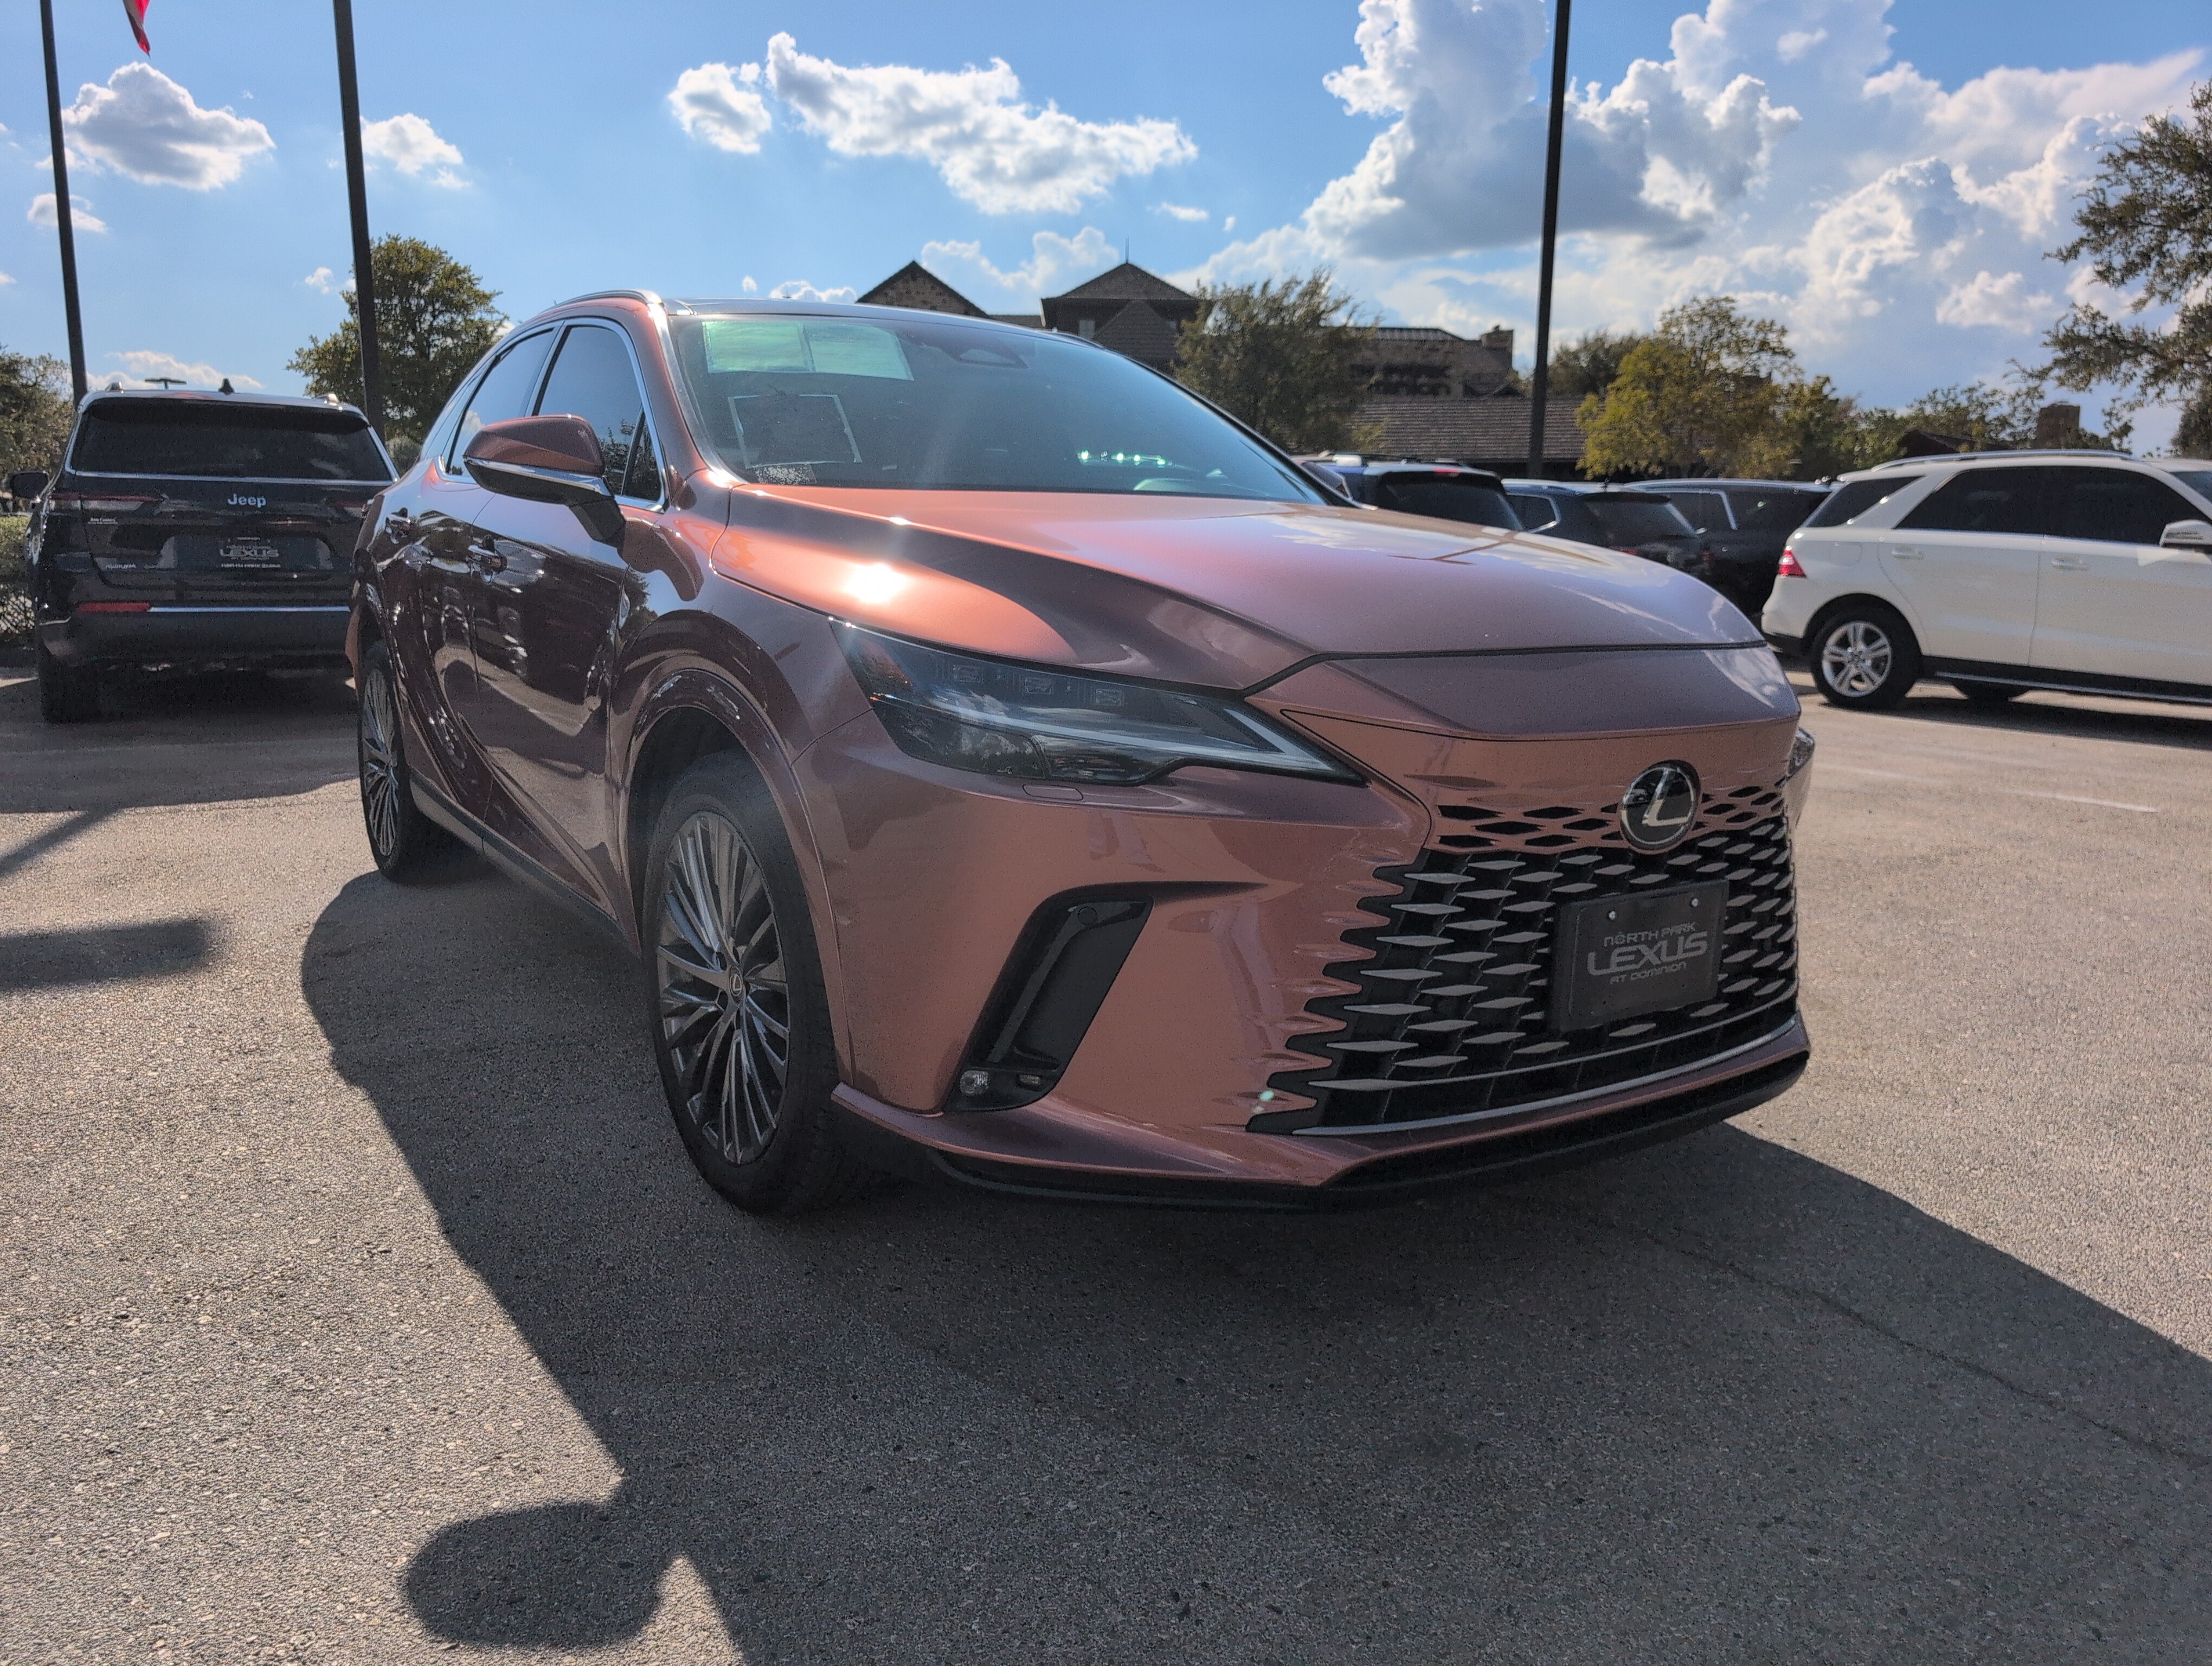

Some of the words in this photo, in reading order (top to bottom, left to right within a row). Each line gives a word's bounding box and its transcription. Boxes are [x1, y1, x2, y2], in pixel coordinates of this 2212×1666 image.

[227, 493, 266, 508] Jeep
[220, 548, 279, 558] LEXUS
[1604, 930, 1659, 947] NORTH
[1661, 921, 1698, 938] PARK
[1587, 931, 1708, 976] LEXUS
[1609, 974, 1626, 985] AT
